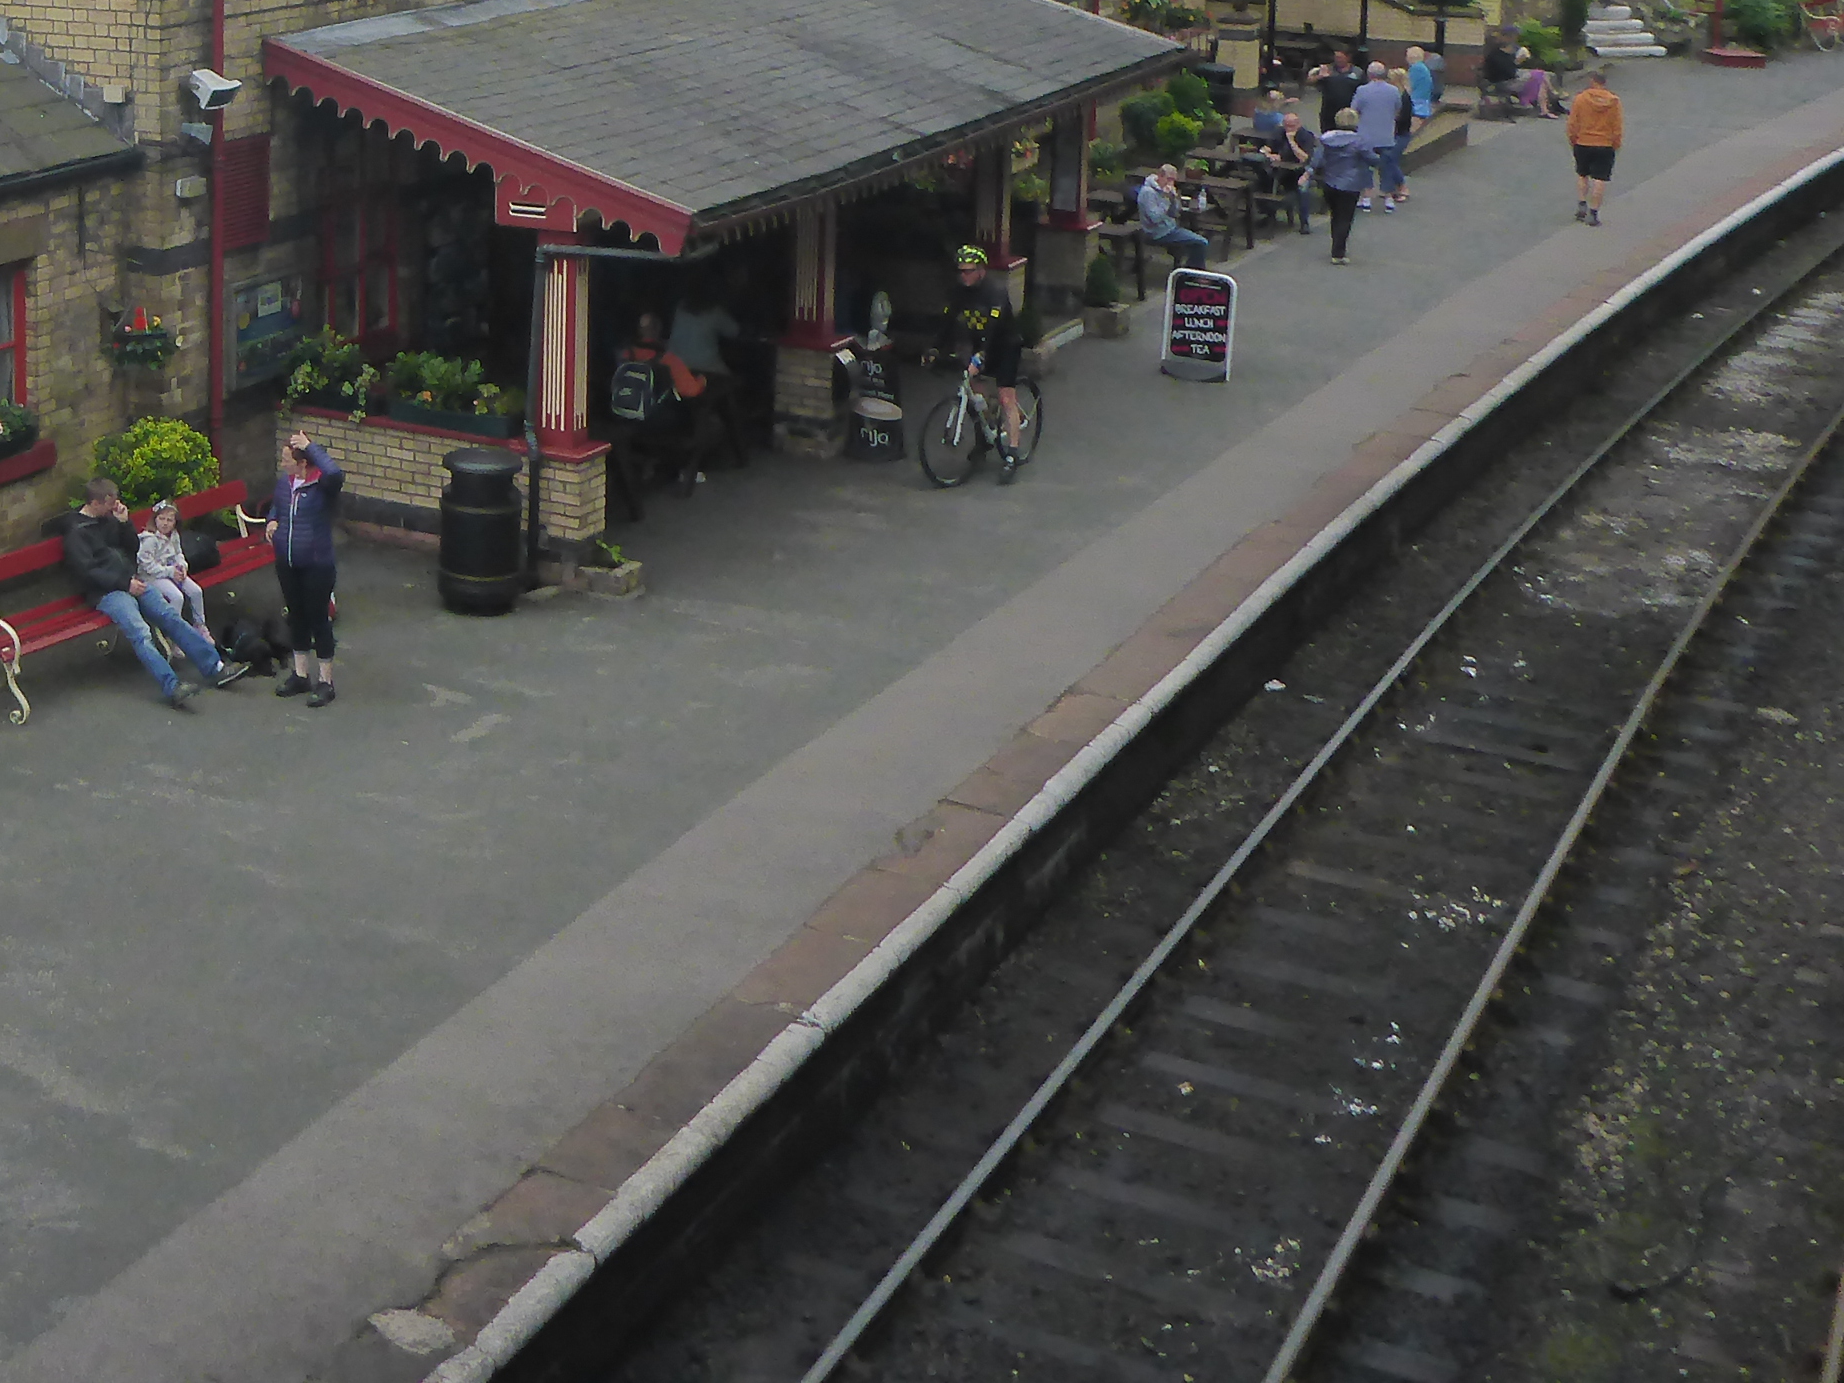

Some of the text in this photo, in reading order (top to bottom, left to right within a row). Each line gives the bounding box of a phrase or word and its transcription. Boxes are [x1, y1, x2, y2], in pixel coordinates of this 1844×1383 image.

[1175, 304, 1226, 315] BREAKFAST
[1184, 317, 1214, 328] LUNCH
[1172, 330, 1226, 342] AFTERNOON
[1190, 344, 1210, 355] TEA
